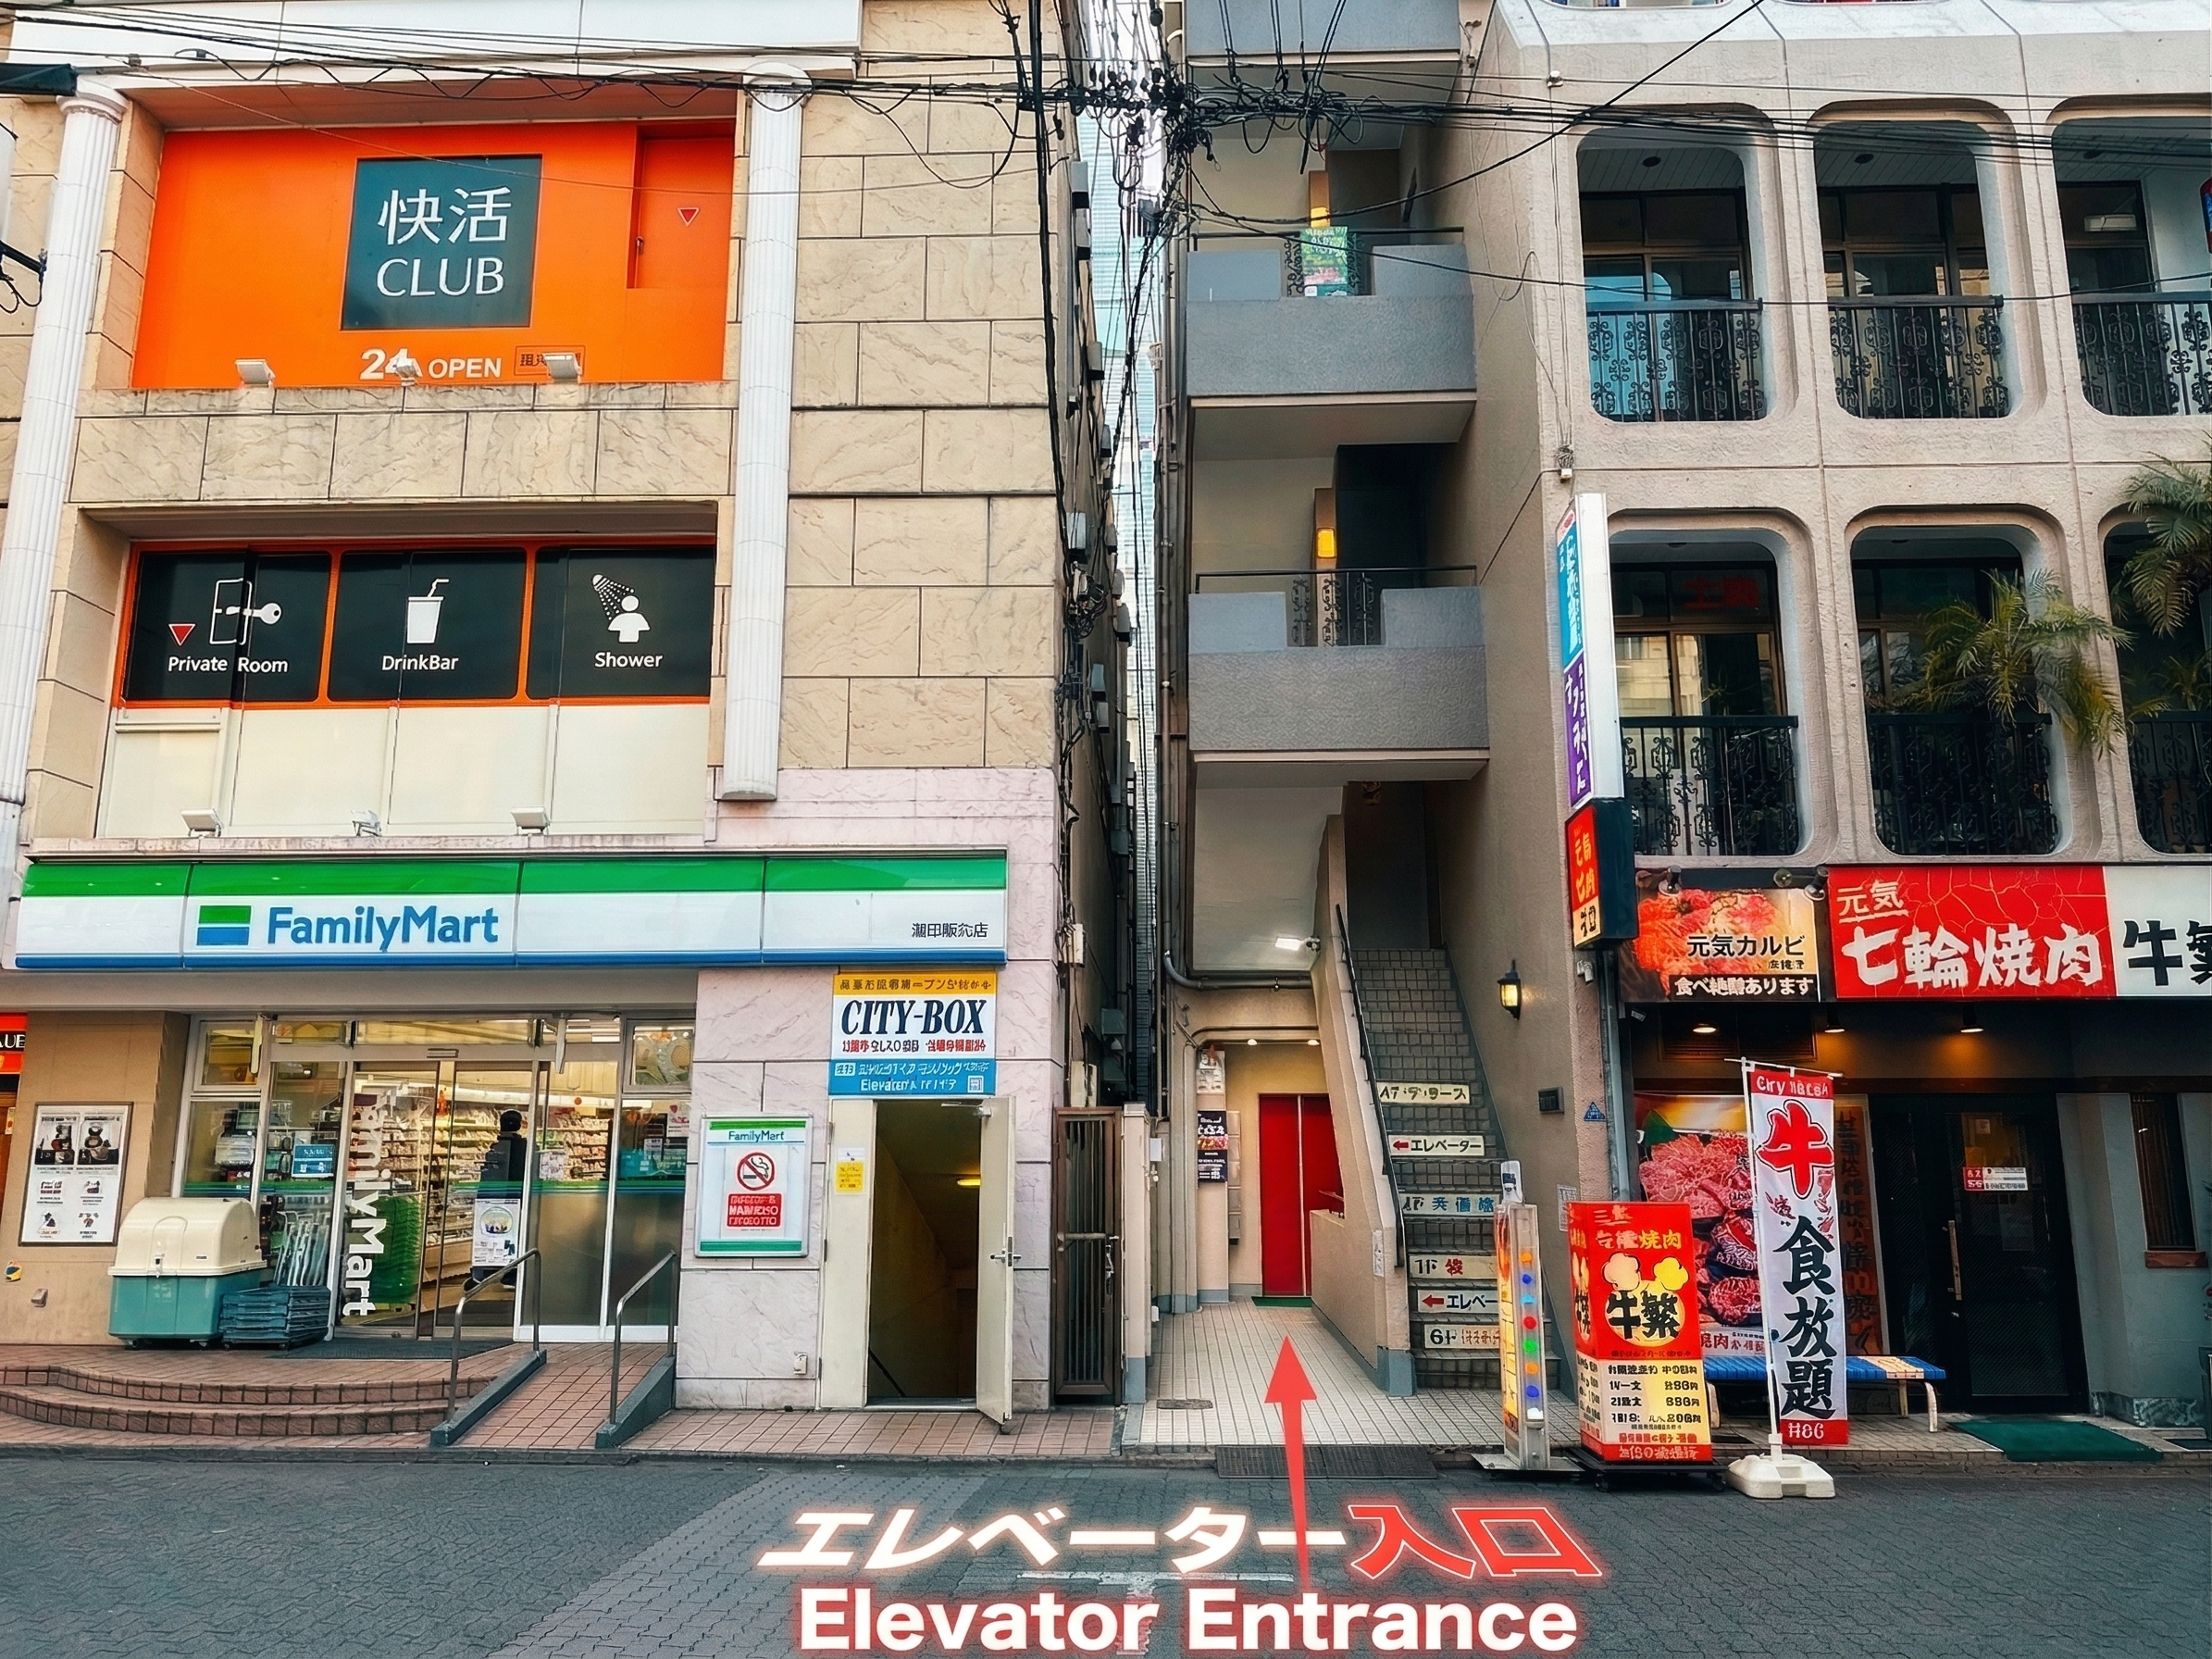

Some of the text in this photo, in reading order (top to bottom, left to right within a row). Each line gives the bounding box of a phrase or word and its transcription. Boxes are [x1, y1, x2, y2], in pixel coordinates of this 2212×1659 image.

[378, 187, 512, 245] 快活
[377, 257, 505, 297] CLUB
[429, 357, 503, 379] OPEN
[168, 657, 289, 673] Private Room
[381, 655, 459, 671] DrinkBar
[594, 652, 663, 668] Shower
[1837, 879, 1906, 915] 元気
[267, 905, 499, 953] FamilyMart
[1687, 934, 1806, 957] 元気カルビ
[1841, 923, 2104, 988] 七輪焼肉
[841, 999, 987, 1035] CITY-BOX
[0, 1033, 26, 1048] UE
[1410, 1139, 1482, 1153] エレベーター
[1755, 1099, 1834, 1200] 牛
[1607, 1290, 1681, 1340] 牛繁
